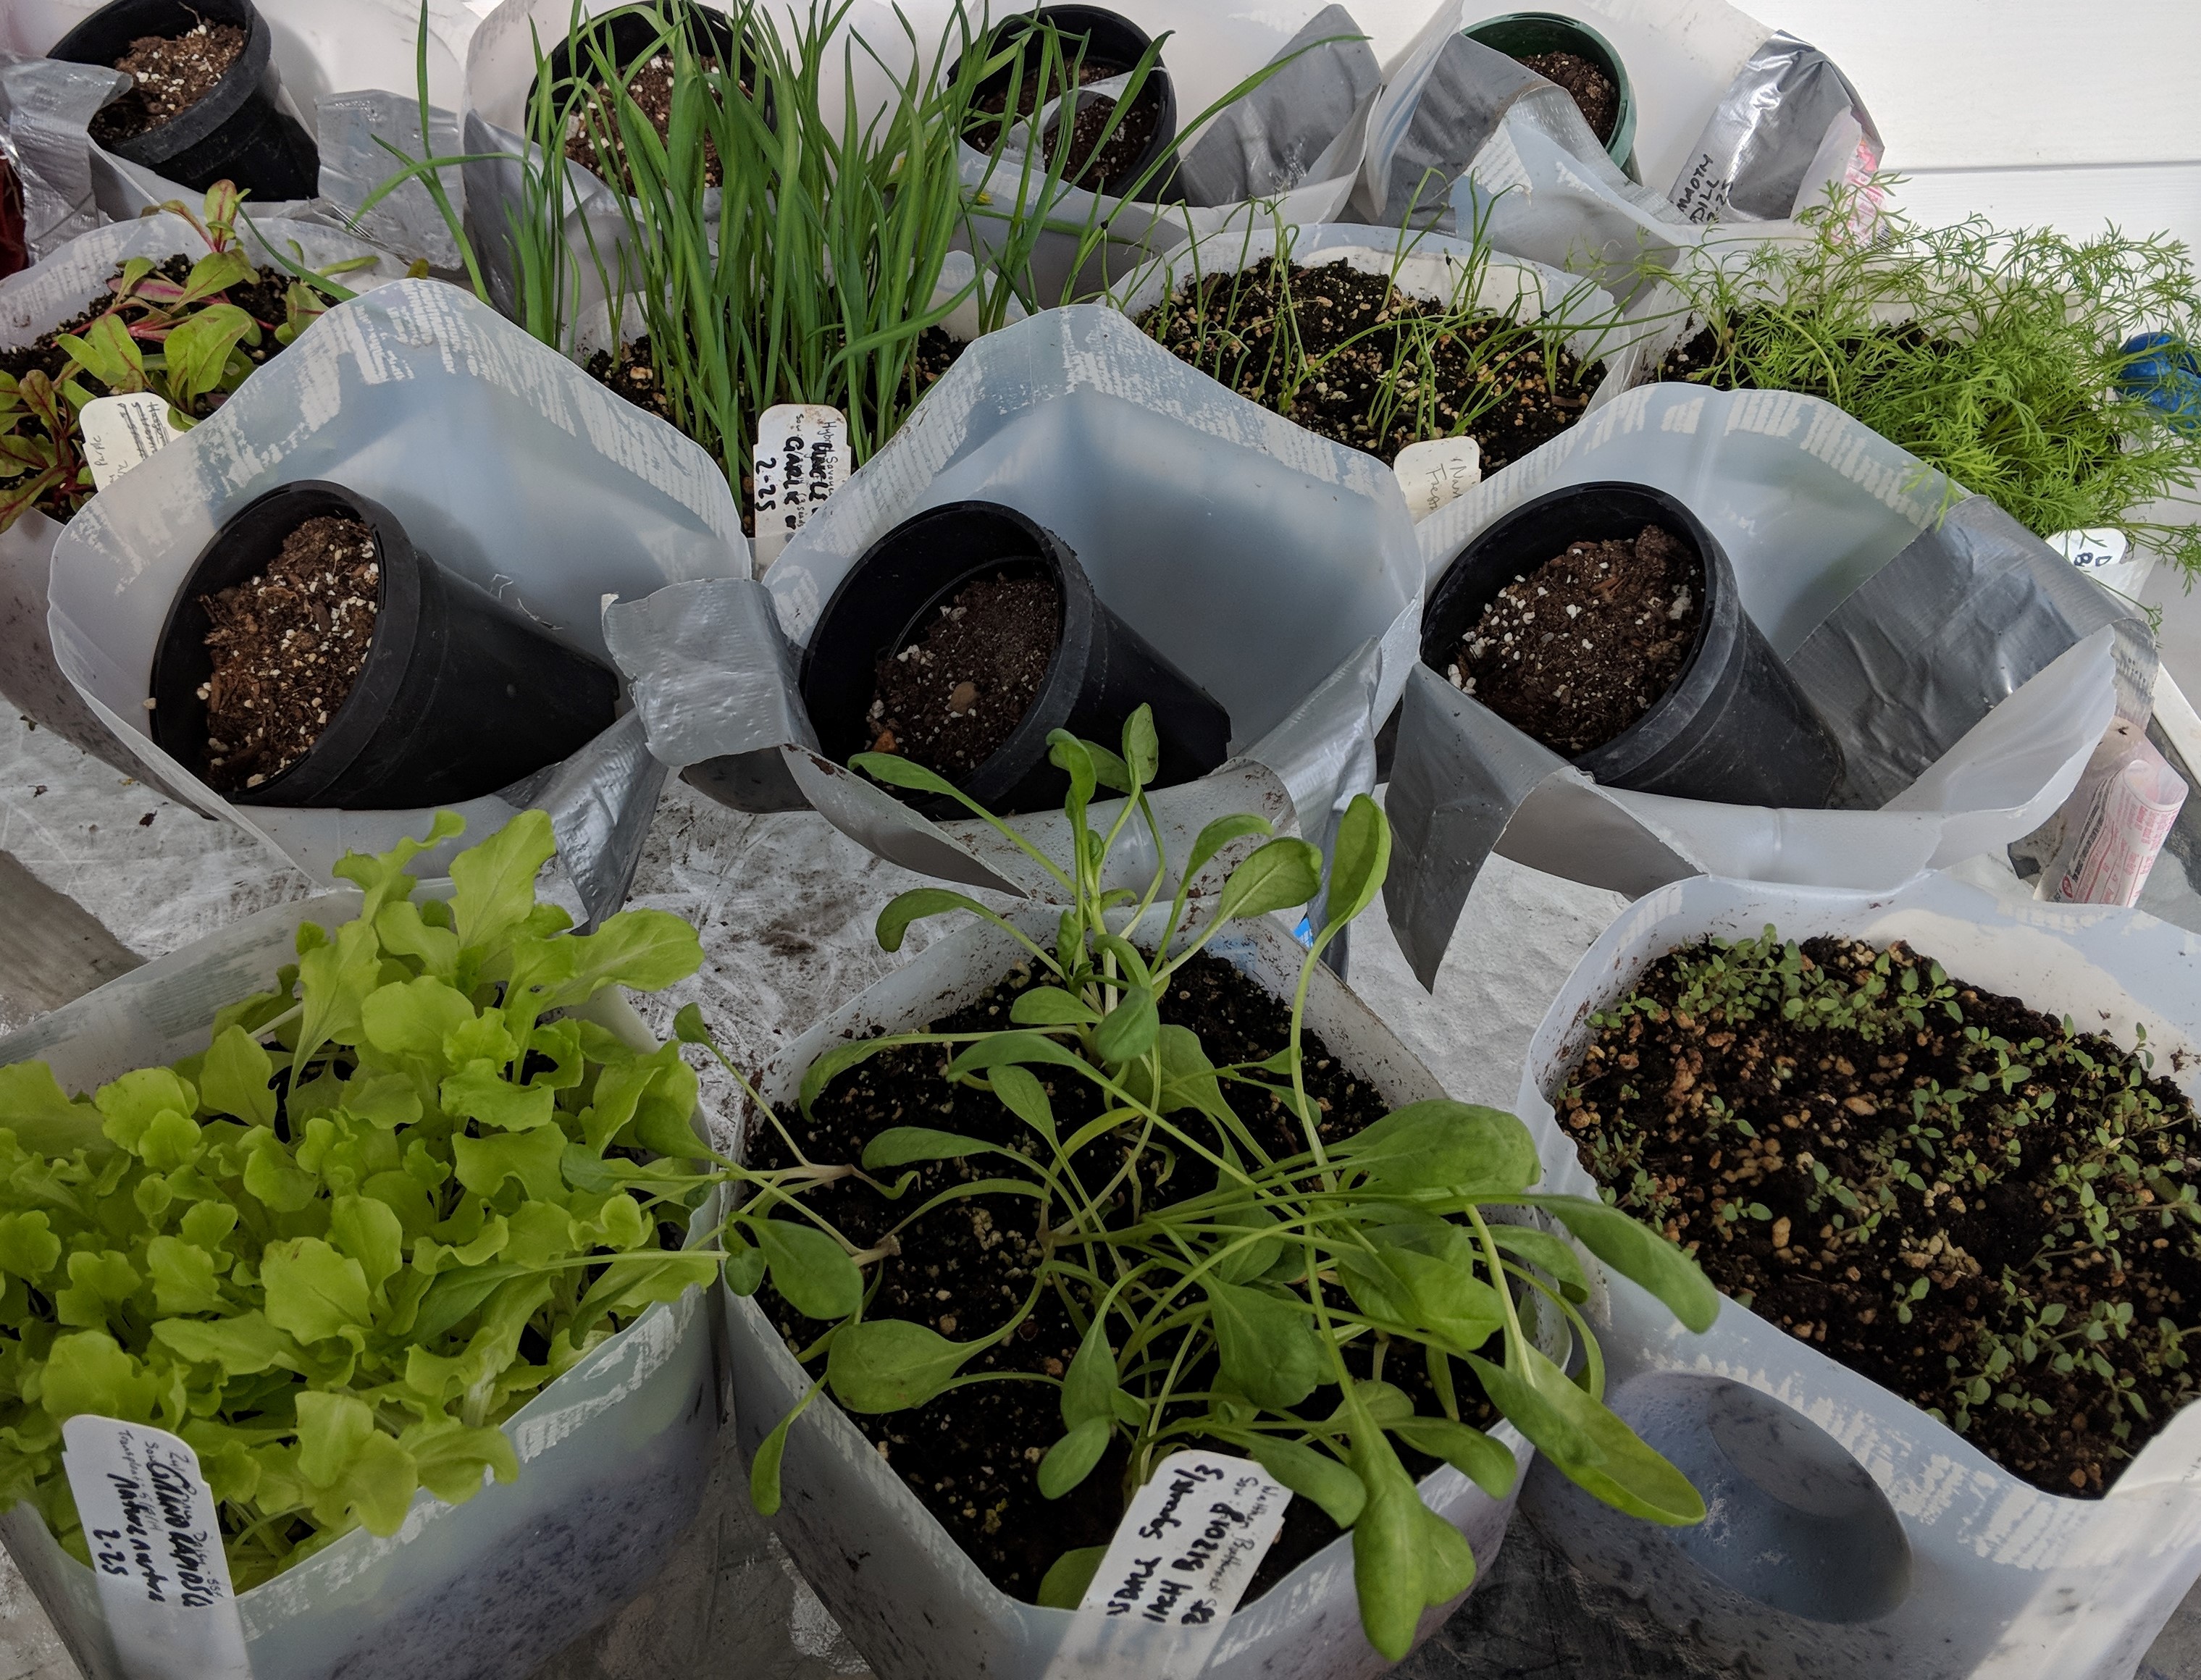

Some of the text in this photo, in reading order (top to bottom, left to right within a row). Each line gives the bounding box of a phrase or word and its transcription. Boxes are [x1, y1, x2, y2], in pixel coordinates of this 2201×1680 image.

[1689, 180, 1719, 224] DILL
[754, 457, 777, 512] 2-25
[93, 1529, 129, 1576] 2-25
